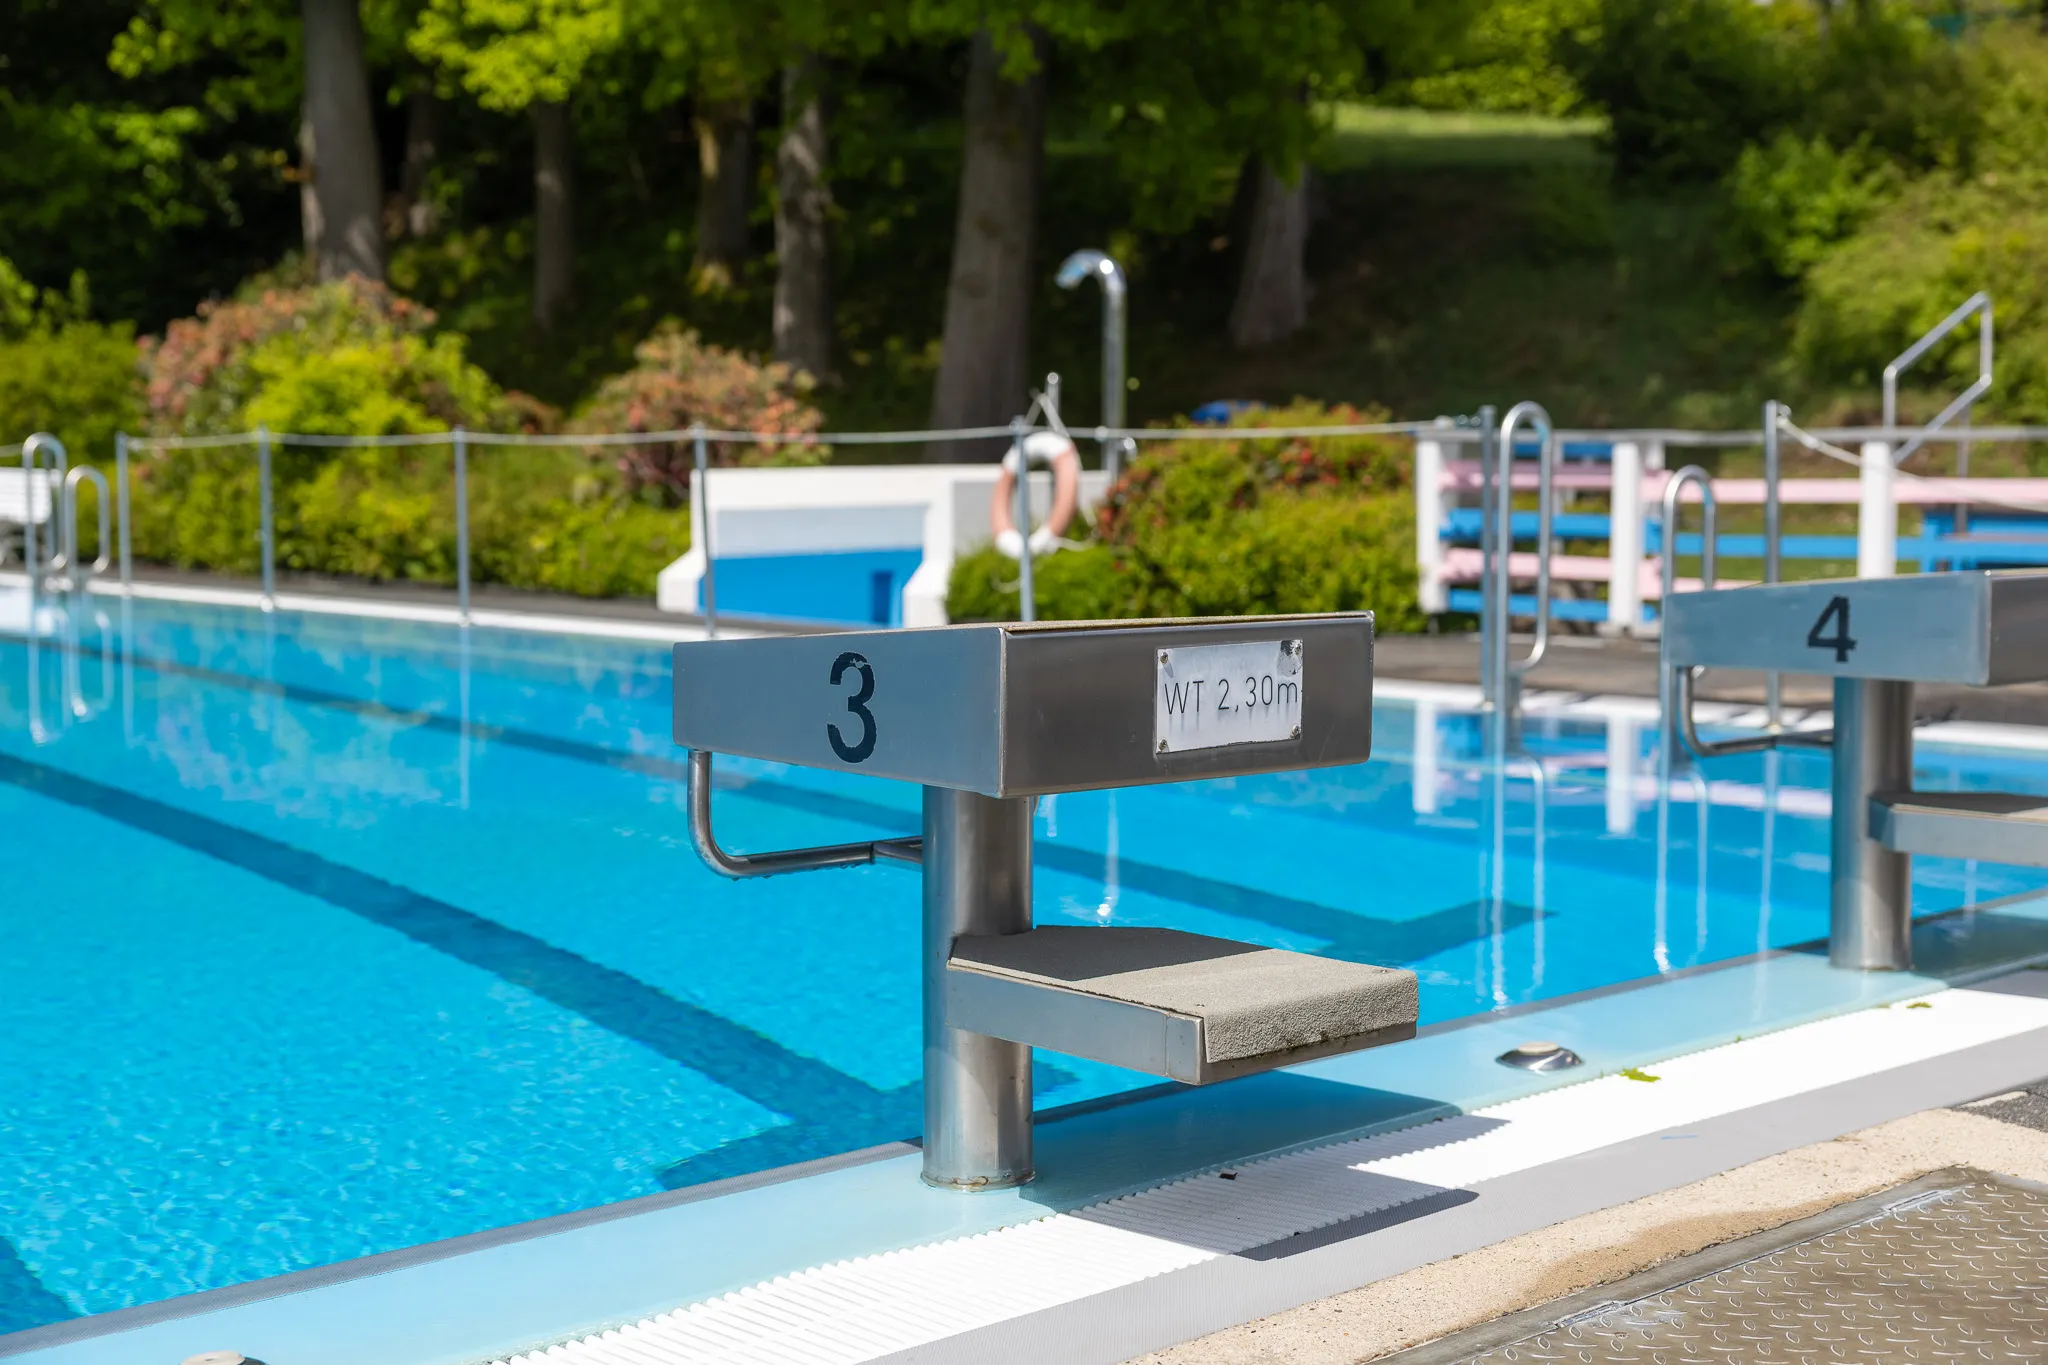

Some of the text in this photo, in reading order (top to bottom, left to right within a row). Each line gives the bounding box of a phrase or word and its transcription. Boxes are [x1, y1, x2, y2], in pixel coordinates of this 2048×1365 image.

[1807, 595, 1857, 663] 4
[826, 651, 877, 763] 3
[1164, 675, 1298, 715] WT 2,30m
